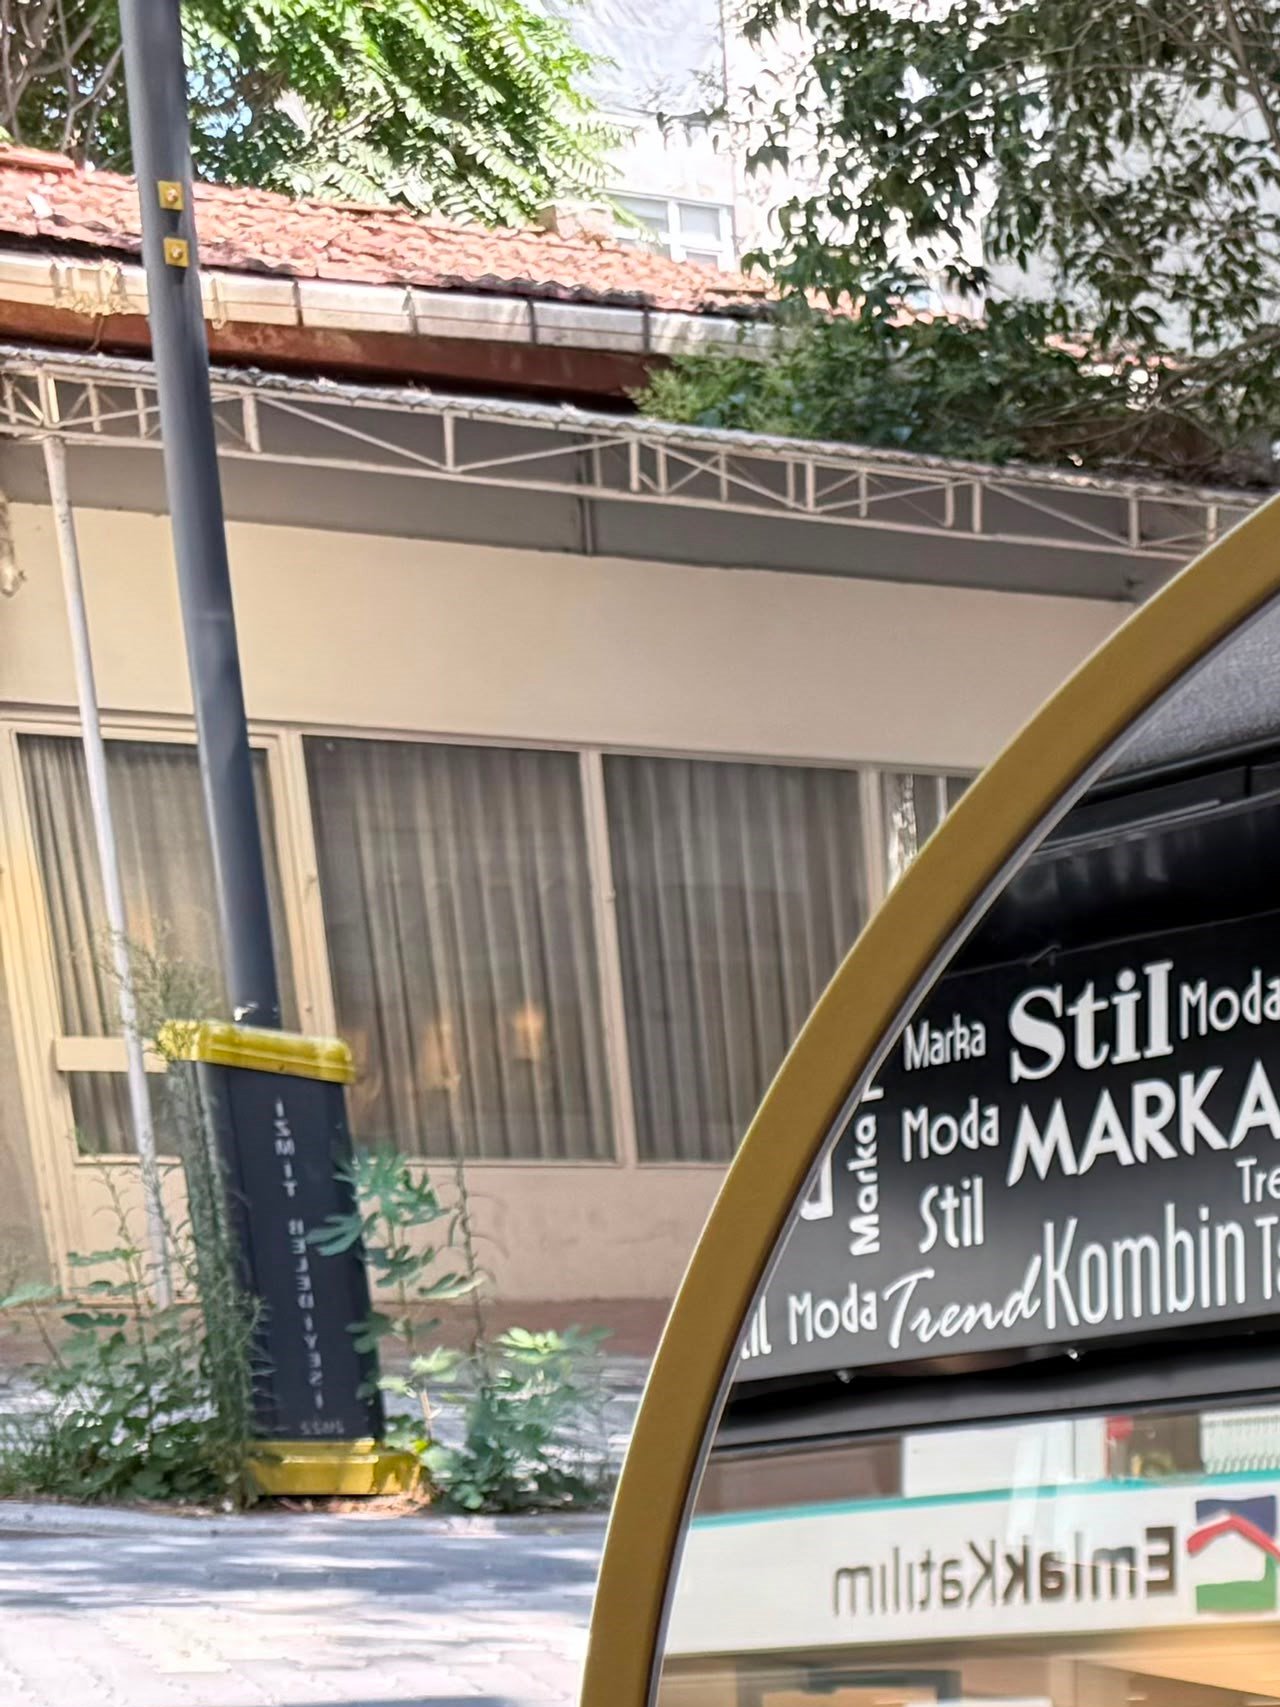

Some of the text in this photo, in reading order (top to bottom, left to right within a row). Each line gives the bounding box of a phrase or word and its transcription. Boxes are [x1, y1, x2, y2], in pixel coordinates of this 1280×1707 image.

[904, 1012, 986, 1071] Marka
[1008, 958, 1173, 1084] Stil
[902, 1096, 999, 1163] Moda
[848, 1115, 881, 1256] Marka
[918, 1176, 984, 1254] Stil
[882, 1254, 1042, 1349] Trend
[1043, 1203, 1246, 1330] Kombin
[788, 1282, 878, 1345] Moda
